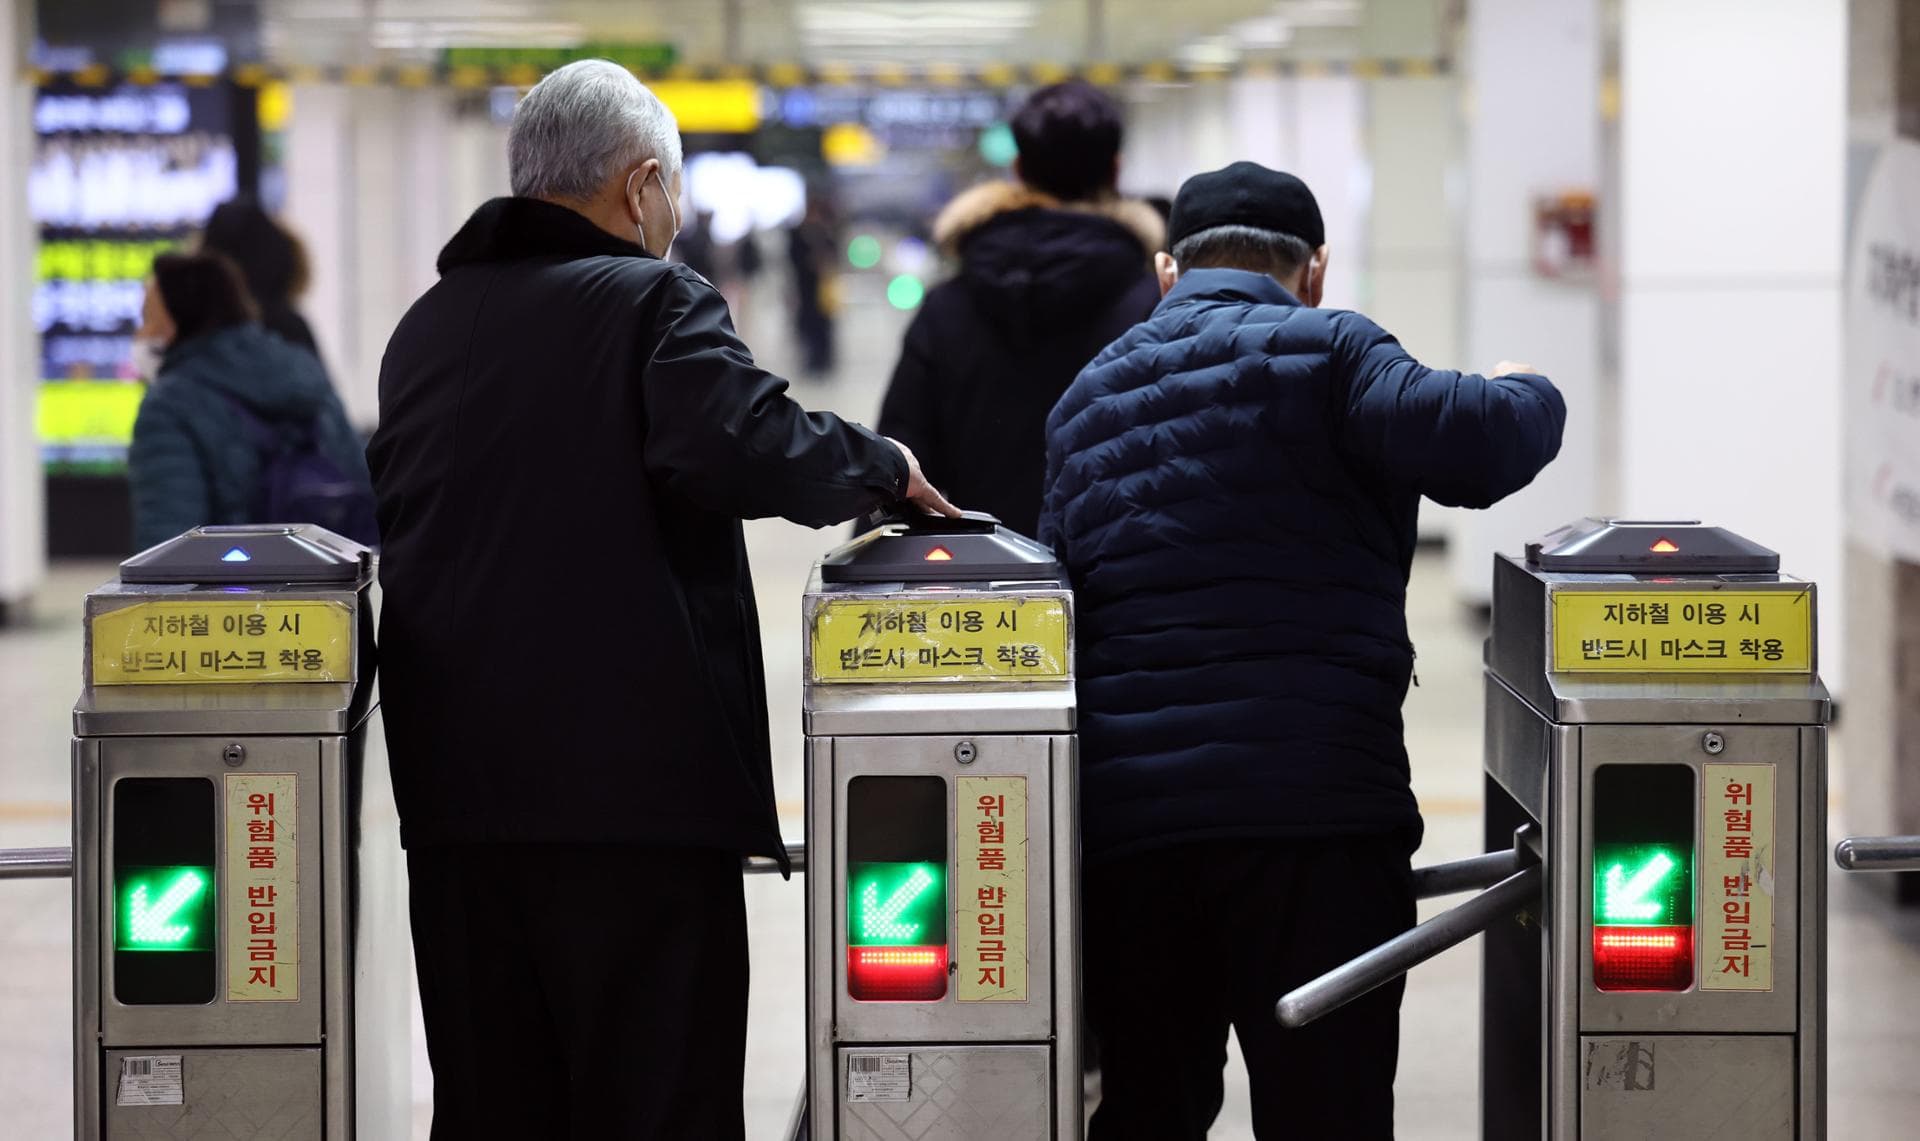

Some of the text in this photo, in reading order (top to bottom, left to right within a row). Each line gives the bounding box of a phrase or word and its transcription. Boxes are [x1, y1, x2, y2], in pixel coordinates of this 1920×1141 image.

[143, 613, 300, 637] 지하철 이용 시
[859, 609, 1017, 635] 지하철 이용 시
[1603, 602, 1760, 625] 지하철 이용 시
[121, 648, 324, 673] 반드시 마스크 착용
[840, 645, 1041, 670] 반드시 마스크 착용
[1581, 638, 1784, 661] 반드시 마스크 착용
[246, 793, 277, 988] 위험품 반입금지
[976, 795, 1007, 988] 위험품 반입금지
[1721, 783, 1753, 977] 위험품 반입금지
